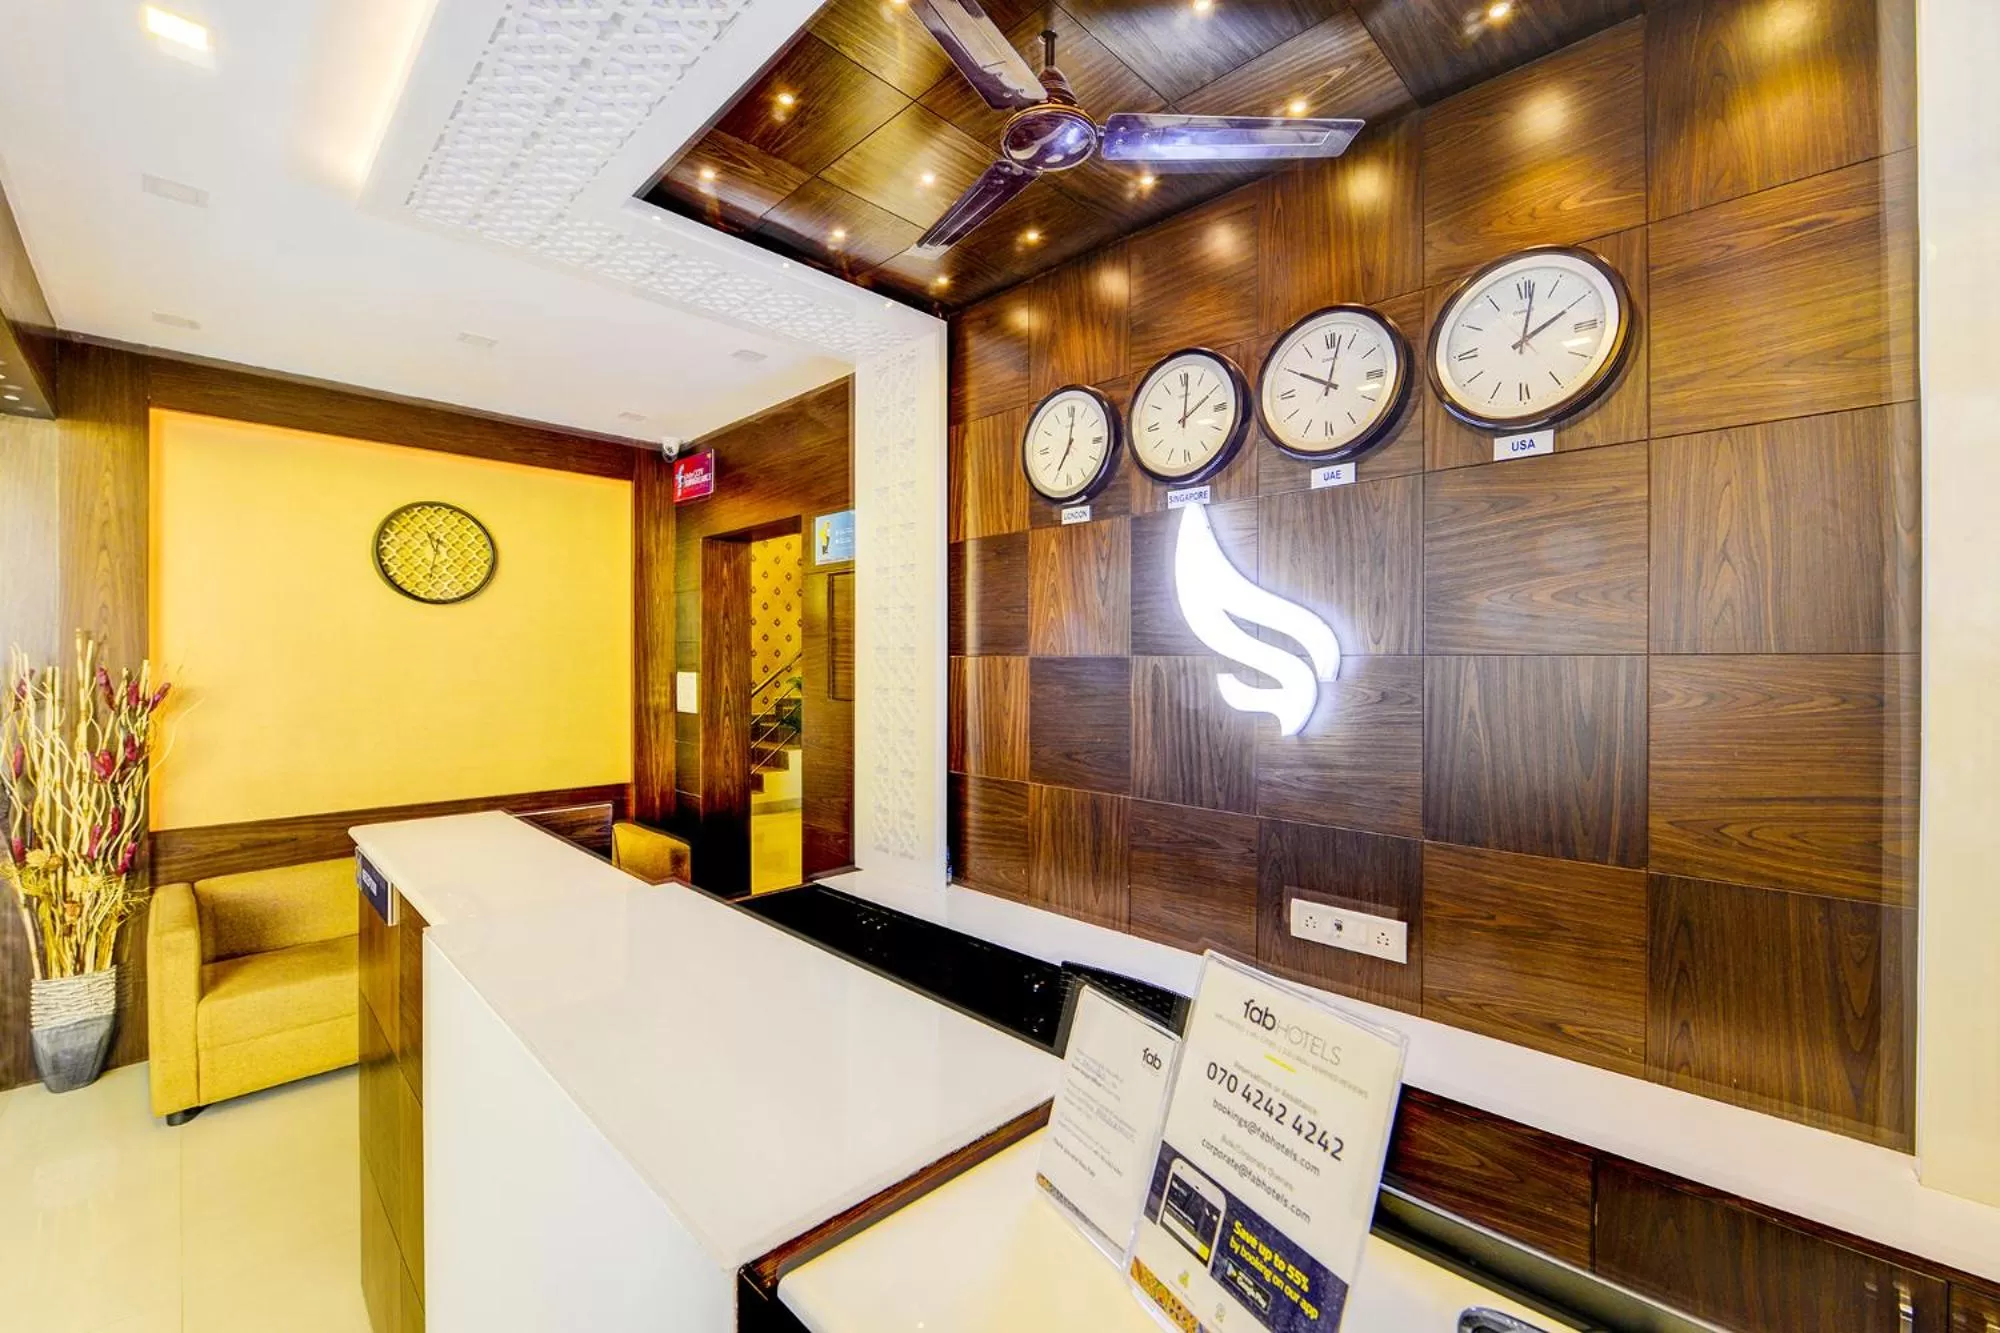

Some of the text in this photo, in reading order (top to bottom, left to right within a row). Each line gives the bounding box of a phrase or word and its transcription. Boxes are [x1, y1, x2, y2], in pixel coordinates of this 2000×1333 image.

[1511, 439, 1535, 452] USA
[1168, 490, 1208, 504] SINGAPORE
[1323, 470, 1341, 481] UAE
[1063, 510, 1088, 520] LONDON
[1142, 1047, 1162, 1070] fab
[1207, 1061, 1344, 1161] 070 4242 4242
[1212, 1098, 1320, 1176] bookings@fabhotels.com
[1201, 1138, 1311, 1224] corporate@fabhotels.com
[1229, 1235, 1240, 1254] by
[1240, 1246, 1273, 1282] booking
[1272, 1276, 1284, 1290] on
[1284, 1285, 1301, 1303] our
[1300, 1298, 1319, 1320] app
[1233, 1220, 1310, 1293] Save up to 55%
